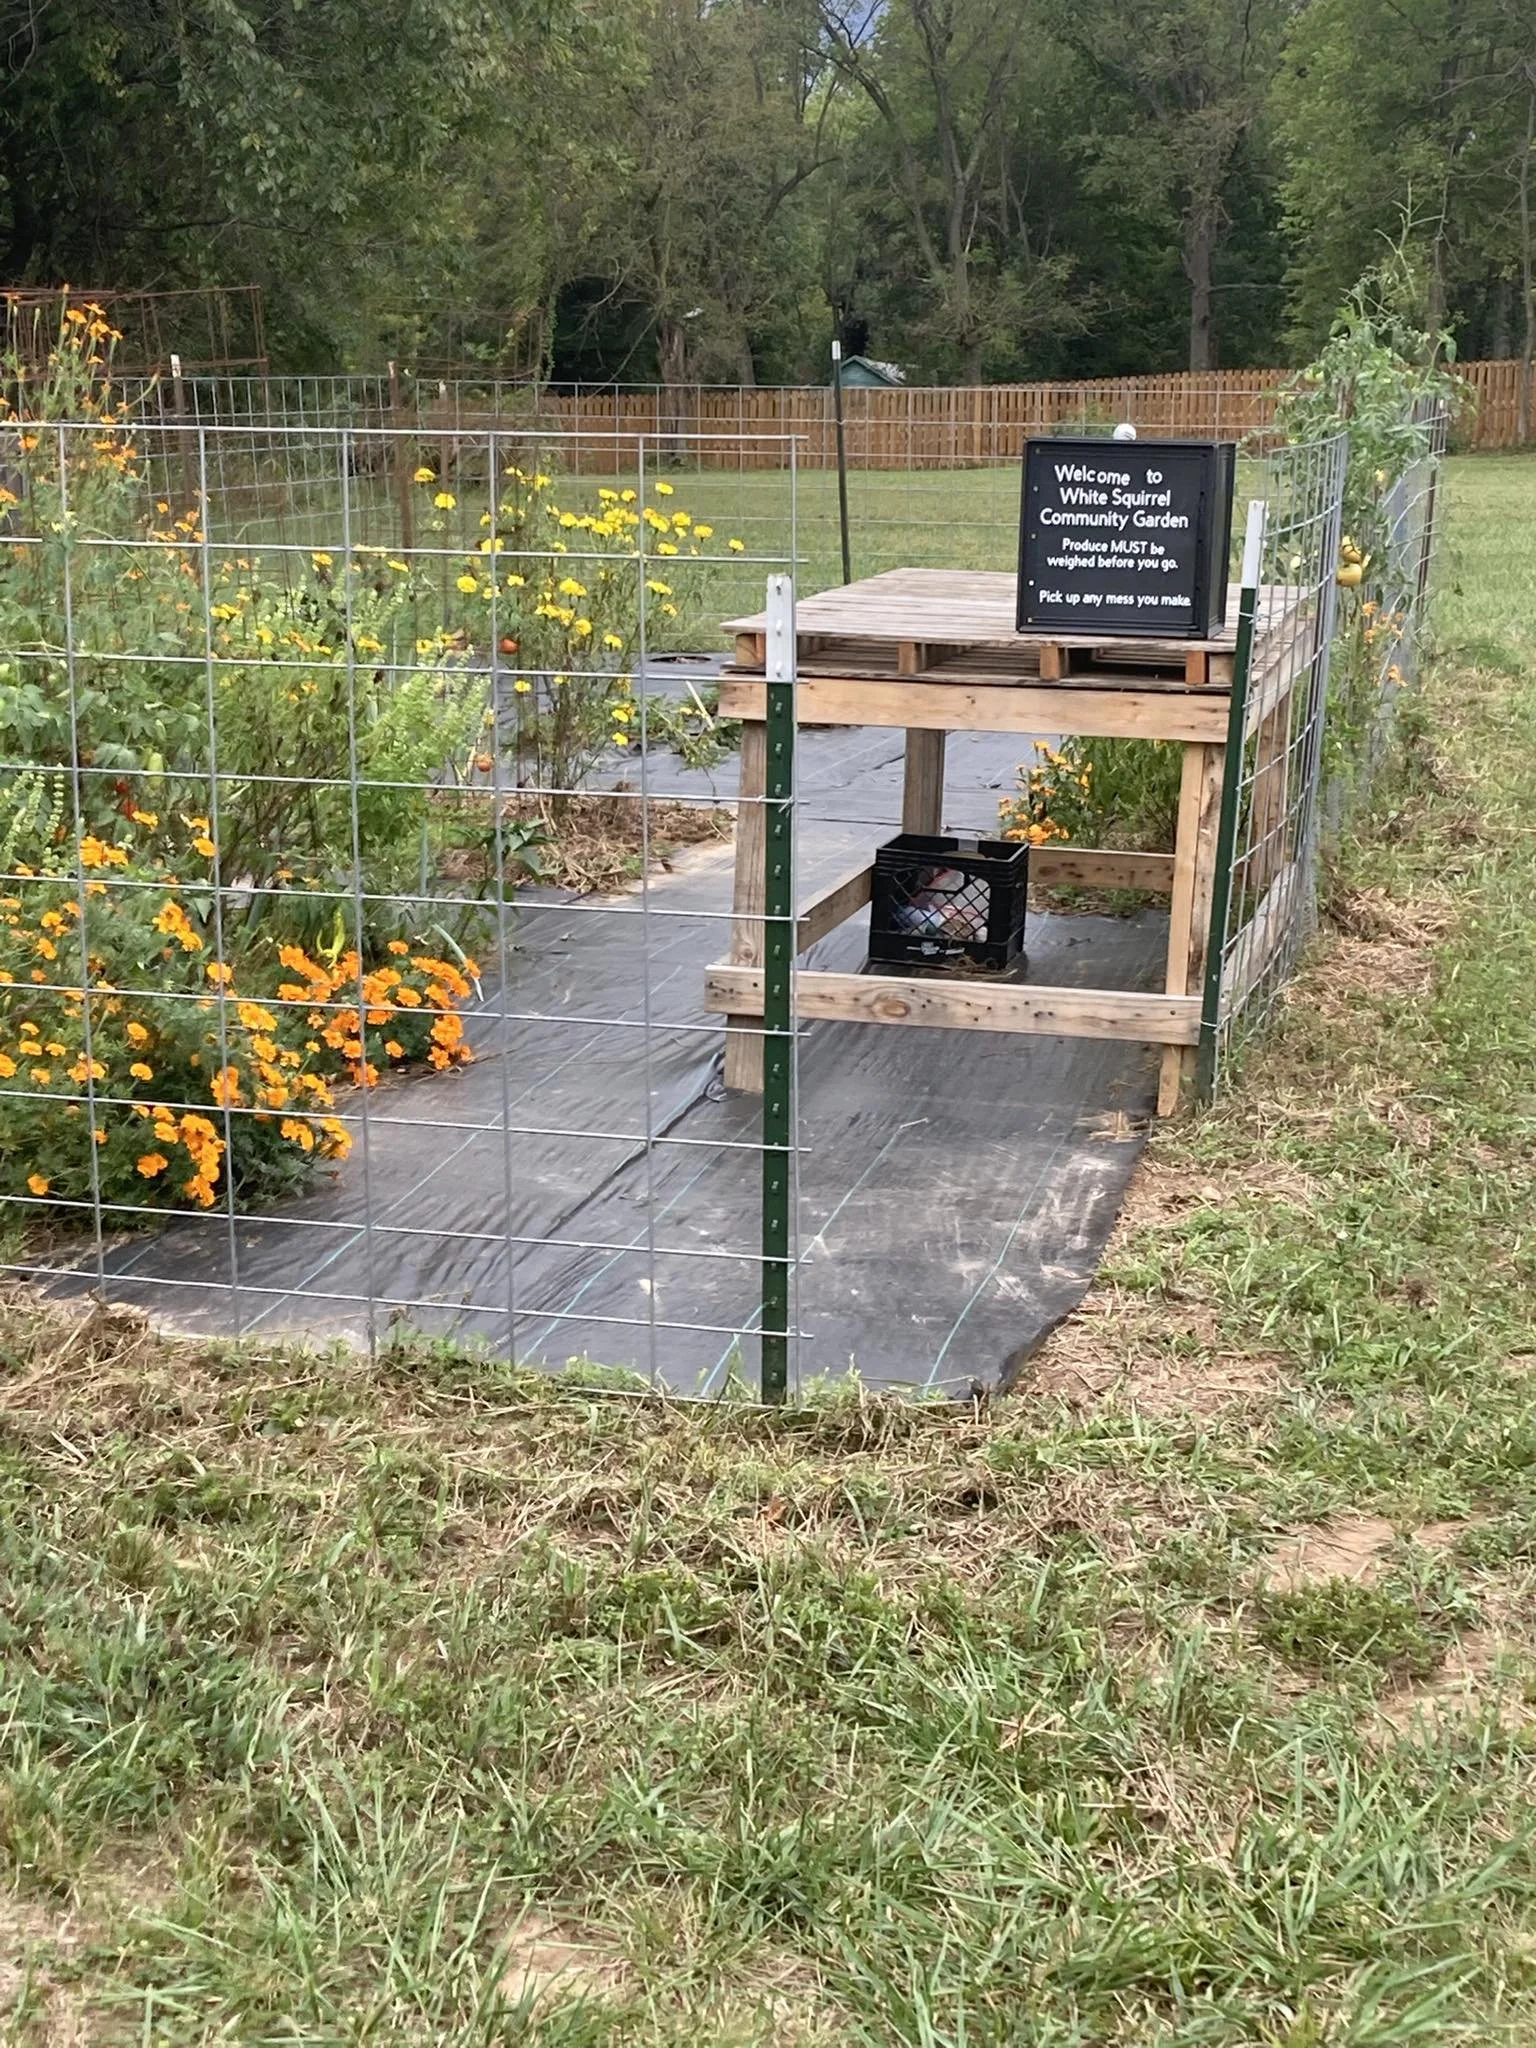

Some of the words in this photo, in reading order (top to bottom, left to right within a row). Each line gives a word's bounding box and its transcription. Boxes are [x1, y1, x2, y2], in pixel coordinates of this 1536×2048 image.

[1054, 464, 1130, 485] Welcome
[1146, 469, 1162, 484] to
[1060, 487, 1108, 505] White
[1112, 489, 1171, 508] Squirrel
[1040, 508, 1129, 531] Community
[1133, 510, 1188, 528] Garden
[1062, 538, 1108, 552] Produce
[1110, 540, 1148, 554] MUST
[1150, 542, 1165, 555] be
[1047, 556, 1095, 569] weighed
[1098, 556, 1135, 568] before
[1138, 559, 1159, 571] you
[1161, 559, 1178, 572] go.
[1039, 590, 1063, 603] Pick
[1066, 594, 1080, 605] up
[1082, 594, 1103, 607] any
[1106, 594, 1134, 604] mess
[1137, 595, 1158, 608] you
